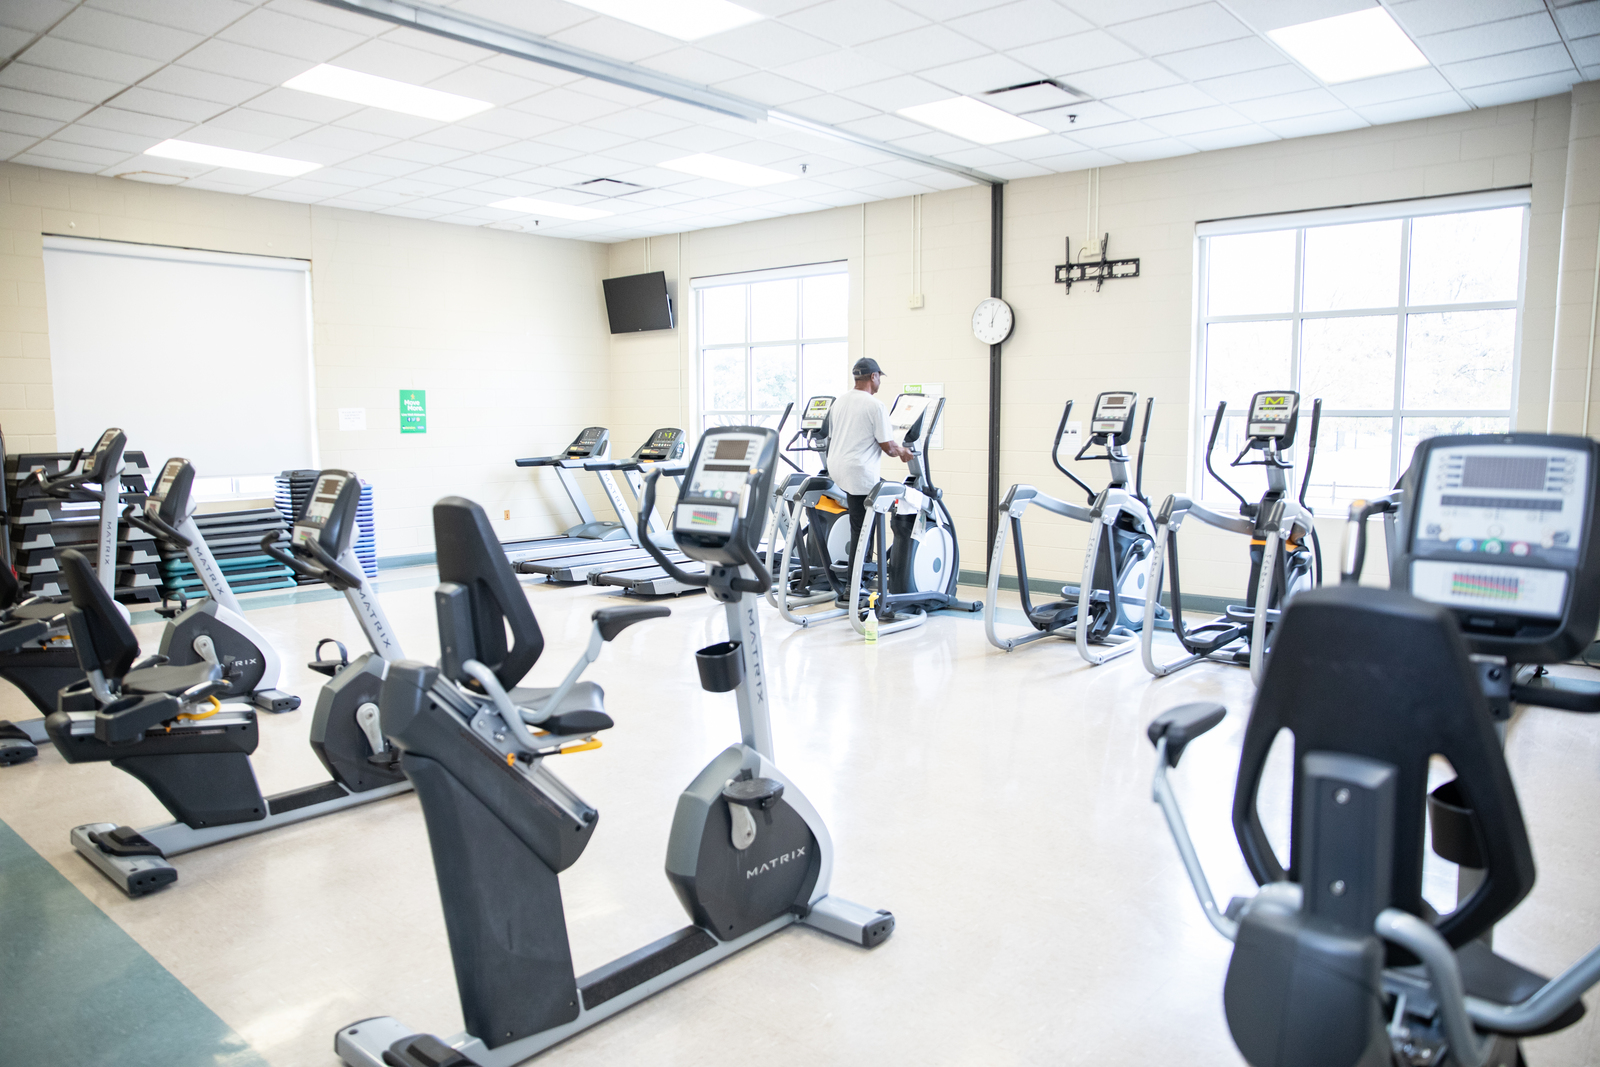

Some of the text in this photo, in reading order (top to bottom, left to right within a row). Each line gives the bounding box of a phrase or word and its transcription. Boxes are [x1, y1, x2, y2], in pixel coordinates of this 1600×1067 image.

[604, 473, 626, 513] MATRIX
[104, 521, 112, 565] MATRIX
[194, 546, 224, 595] MATRIX
[356, 586, 391, 649] MATRIX
[748, 608, 763, 704] MATRIX
[746, 846, 806, 879] MATRIX
